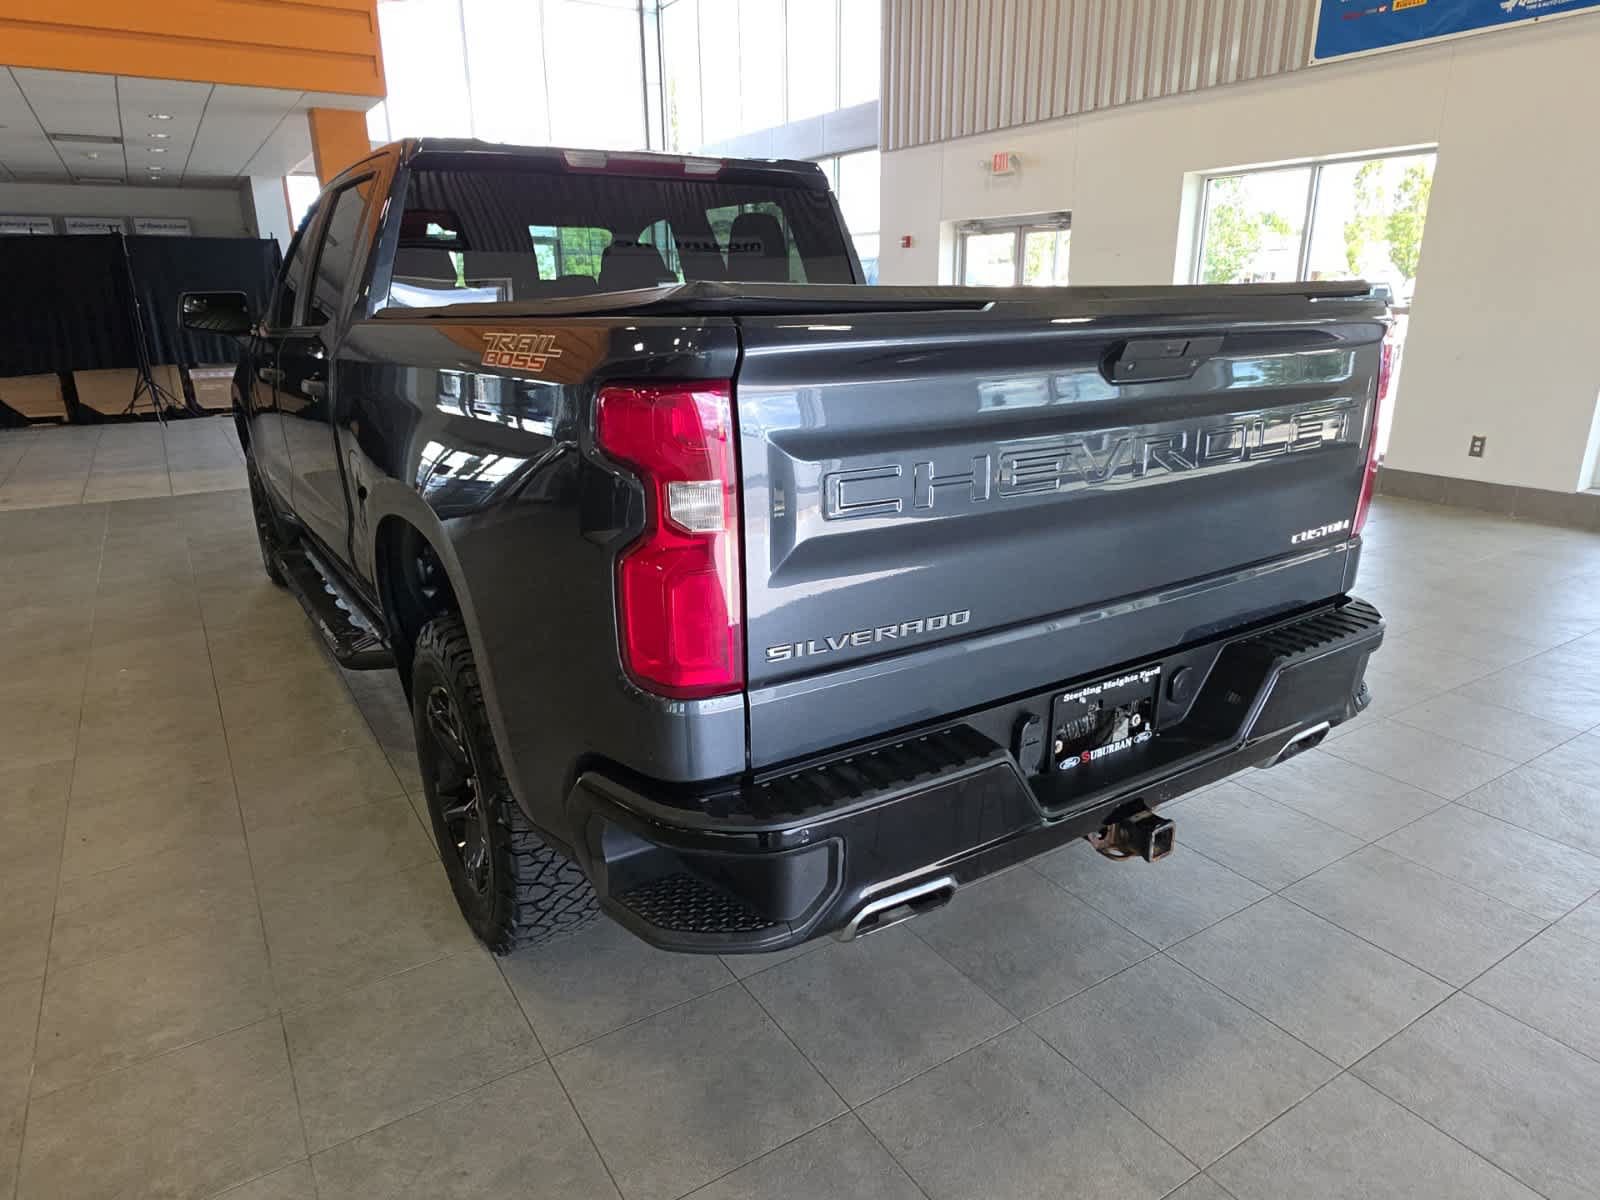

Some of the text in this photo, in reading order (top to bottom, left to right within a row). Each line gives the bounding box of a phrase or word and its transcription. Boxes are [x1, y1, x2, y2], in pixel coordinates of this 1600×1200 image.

[482, 332, 563, 357] TRAIL
[481, 350, 547, 372] BOSS
[822, 398, 1352, 520] CHEVROLET
[766, 608, 971, 663] SILVERADO
[1063, 665, 1161, 702] Sterling Heights Ford
[1080, 736, 1134, 763] SUBURBAN
